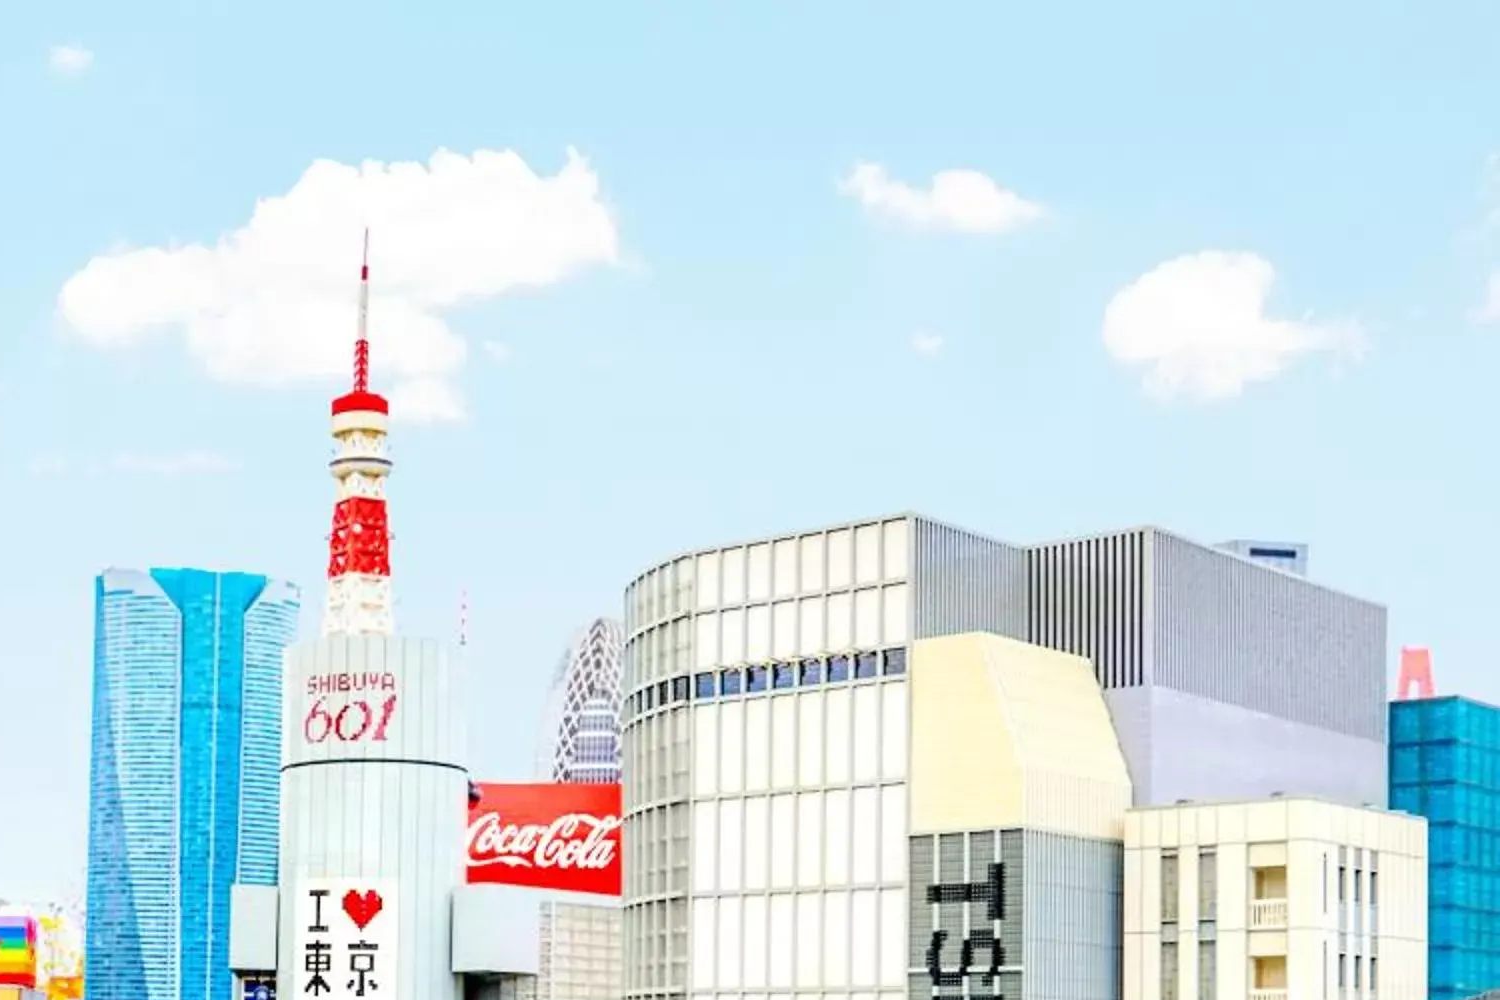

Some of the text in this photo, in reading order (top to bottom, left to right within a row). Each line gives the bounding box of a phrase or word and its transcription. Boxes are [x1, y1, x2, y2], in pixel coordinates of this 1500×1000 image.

[307, 672, 395, 695] SHIBUYA
[305, 694, 396, 744] 601
[308, 889, 330, 932] I
[304, 939, 379, 997] 東京
